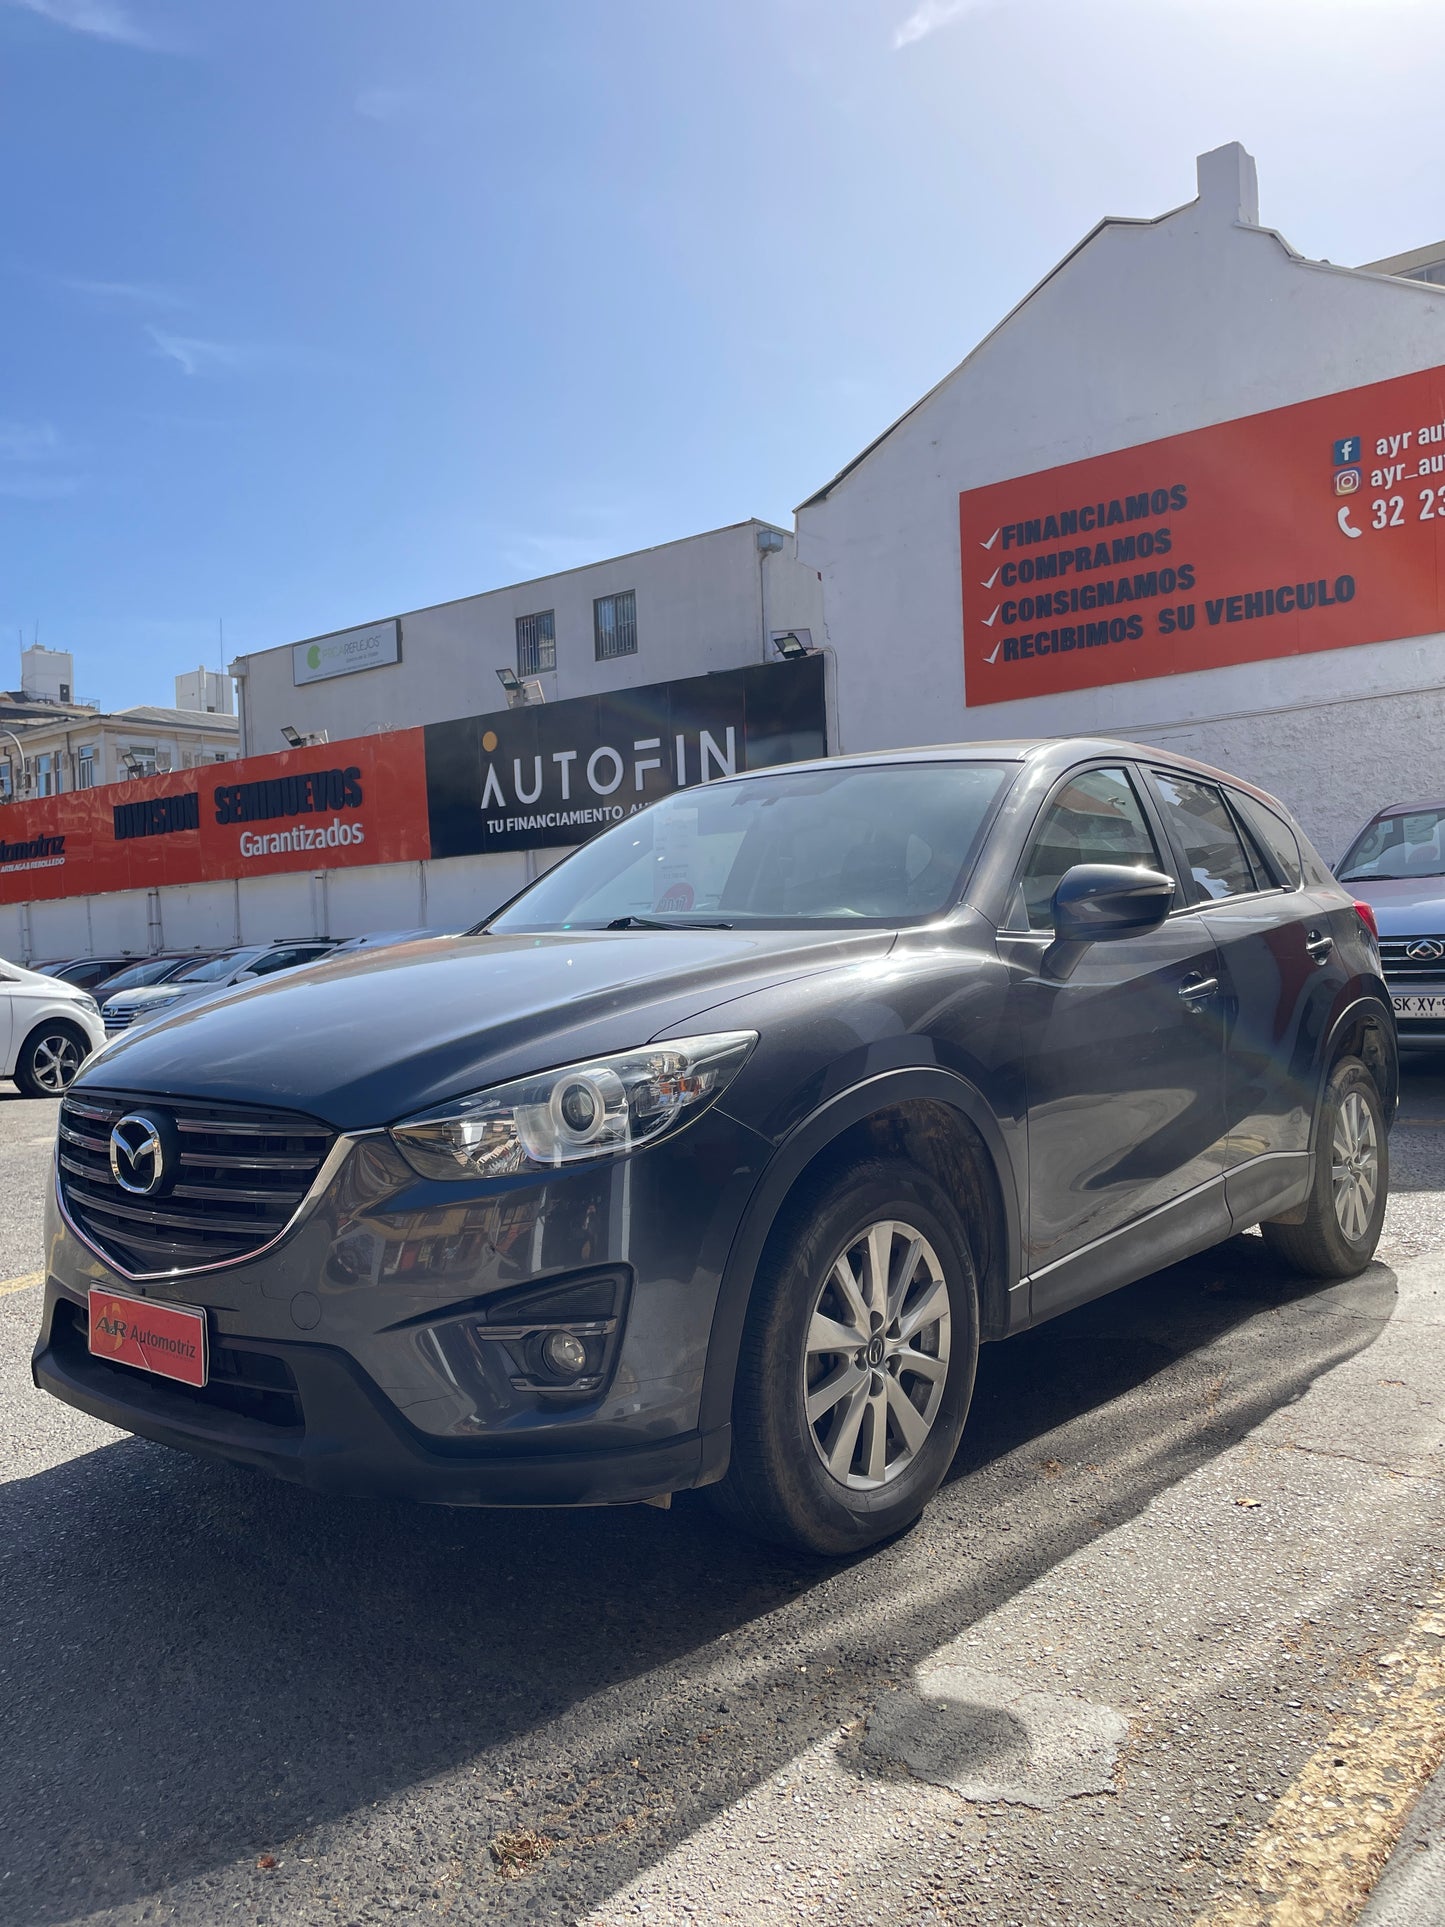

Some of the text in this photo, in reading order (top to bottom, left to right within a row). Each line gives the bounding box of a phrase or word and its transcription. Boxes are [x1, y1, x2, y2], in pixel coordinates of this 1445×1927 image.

[1376, 431, 1412, 458] ayr
[1002, 484, 1187, 550] FINANCIAMOS
[1372, 495, 1405, 529] 32
[1001, 528, 1172, 587] COMPRAMOS
[1001, 564, 1195, 625] CONSIGNAMOS
[1003, 574, 1356, 662] RECIBIMOS SU VEHICULO
[481, 726, 737, 809] AUTOFIN
[113, 766, 363, 841] DIVISION SEMINUEVOS
[487, 819, 504, 834] TU
[506, 805, 624, 832] FINANCIAMIENTO
[239, 818, 364, 858] Garantizados
[130, 1324, 196, 1358] Automotriz
